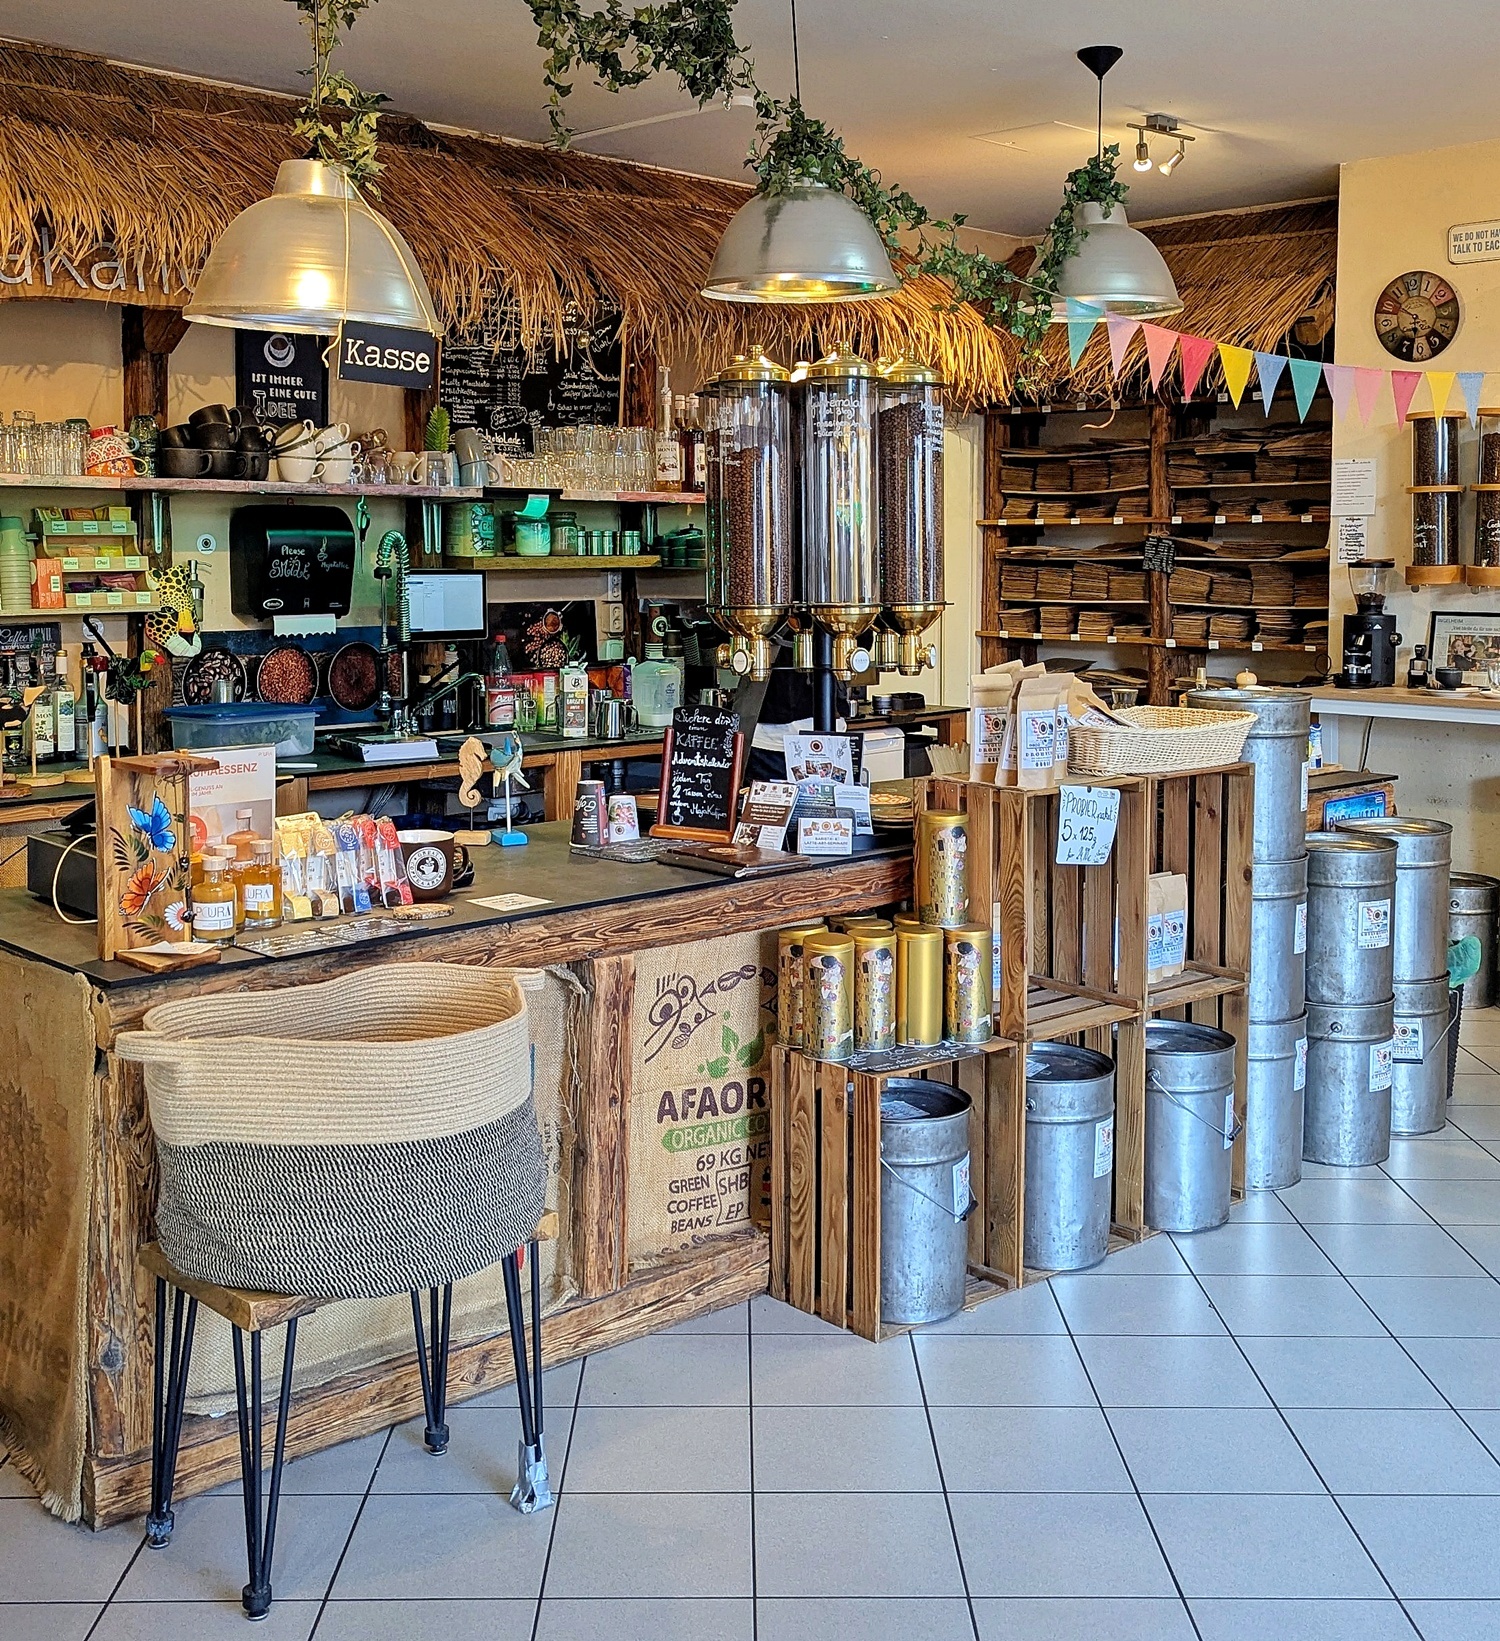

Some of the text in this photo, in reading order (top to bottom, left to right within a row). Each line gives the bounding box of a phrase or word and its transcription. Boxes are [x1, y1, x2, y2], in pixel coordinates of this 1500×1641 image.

[1453, 232, 1463, 242] WE
[1464, 231, 1474, 241] DO
[1475, 230, 1489, 240] NOT
[1452, 243, 1471, 254] TALK
[1473, 242, 1482, 252] TO
[344, 338, 431, 374] Kasse
[251, 373, 304, 387] IST IMMER
[269, 387, 317, 401] EINE GUTE
[281, 545, 305, 556] Please
[676, 732, 719, 751] KAFFEE
[190, 762, 258, 778] OMAESSENZ
[672, 784, 682, 799] 2
[1061, 818, 1073, 842] 5
[656, 1077, 768, 1124] AFAOR
[671, 1119, 742, 1150] ORGANIC
[696, 1153, 716, 1172] 69
[720, 1147, 742, 1167] KG
[668, 1172, 749, 1196] GREEN SHB
[667, 1194, 718, 1214] COFFEE
[725, 1201, 745, 1221] EP
[671, 1214, 713, 1235] BEANS
